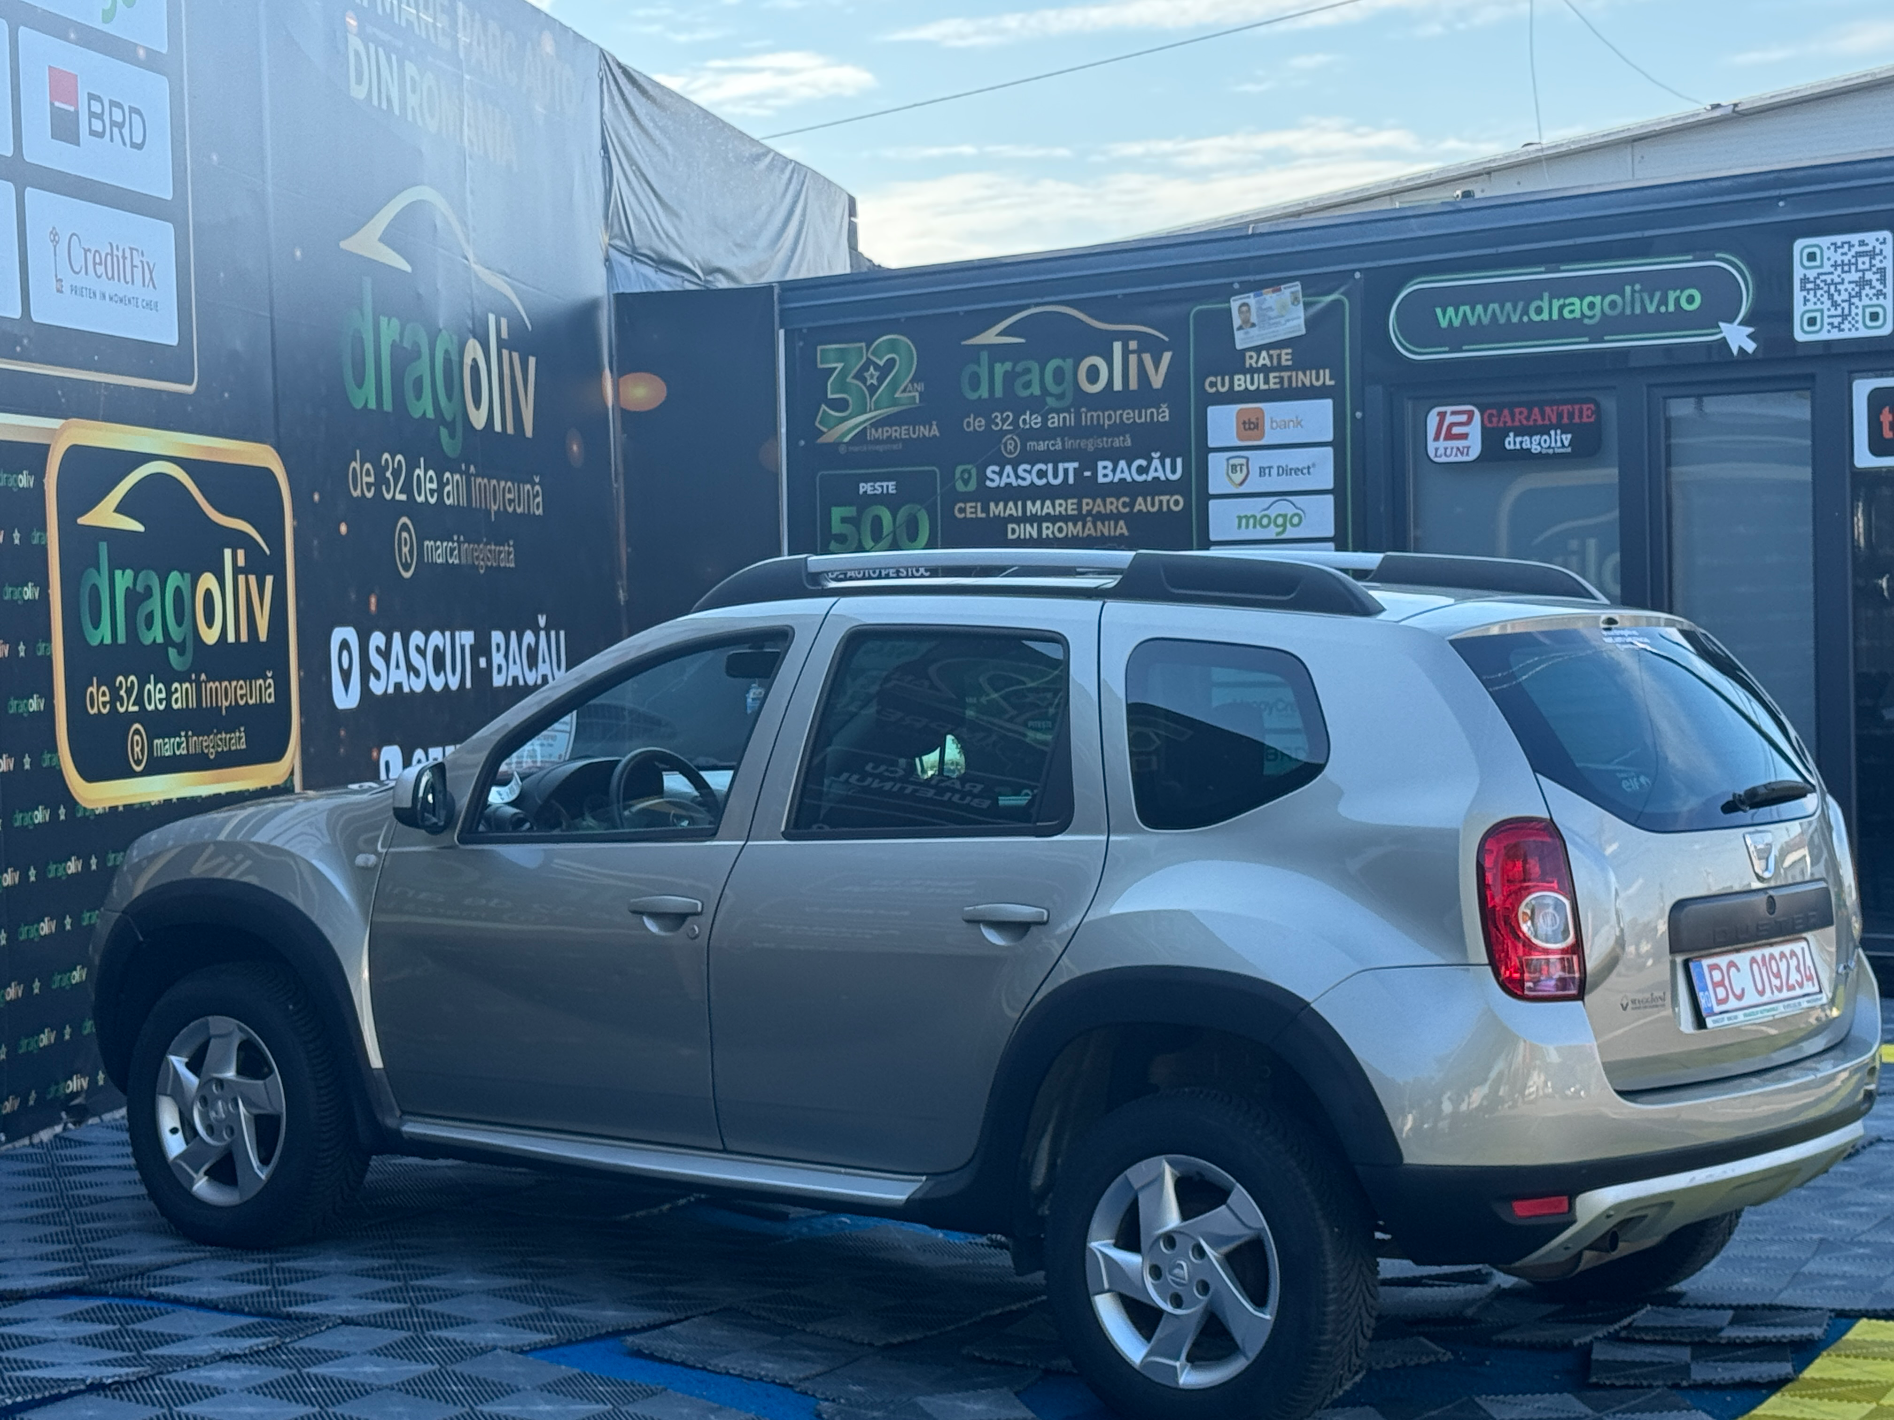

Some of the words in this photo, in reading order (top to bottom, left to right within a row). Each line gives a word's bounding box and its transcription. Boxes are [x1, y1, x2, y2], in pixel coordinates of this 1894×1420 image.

[347, 32, 400, 117] DIN
[87, 91, 147, 151] BRD
[67, 232, 157, 290] CreditFix
[70, 284, 97, 299] PRIETEN
[108, 293, 139, 308] MOMENTE
[1434, 283, 1702, 329] www.dragoliv.ro
[340, 275, 537, 459] dragoliv
[1245, 348, 1293, 368] RATE
[960, 340, 1173, 409] dragoliv
[1204, 375, 1230, 393] CU
[1233, 369, 1335, 392] BULETINUL
[906, 382, 925, 394] ANI
[964, 412, 985, 432] de
[991, 411, 1013, 431] 32
[1019, 410, 1042, 429] de
[1047, 408, 1075, 428] ani
[1081, 402, 1170, 429] împreună
[1241, 416, 1260, 432] tbi
[1269, 415, 1304, 431] bank
[1432, 409, 1475, 442] 12
[1483, 403, 1597, 428] GARANTIE
[866, 421, 940, 441] ÎMPREUNĂ
[1504, 428, 1573, 454] dragoliv
[1026, 438, 1062, 452] marcă
[1433, 445, 1472, 460] LUNI
[985, 462, 1079, 488] SASCUT
[1097, 451, 1183, 484] BACĂU
[1230, 463, 1245, 475] BT
[1258, 465, 1274, 478] BT
[348, 448, 375, 499] de
[381, 452, 408, 502] 32
[412, 457, 438, 505] de
[443, 463, 467, 507] ani
[470, 464, 544, 522] împreună
[859, 481, 897, 495] PESTE
[954, 501, 986, 519] CEL
[989, 500, 1022, 518] MAI
[1026, 498, 1078, 516] MARE
[1082, 497, 1130, 514] PARC
[1133, 494, 1184, 513] AUTO
[828, 503, 930, 553] 500
[1007, 522, 1038, 540] DIN
[1042, 517, 1129, 539] ROMÂNIA
[1236, 511, 1303, 538] mogo
[423, 534, 459, 565] marcă
[3, 581, 40, 605] dragoliv
[79, 540, 275, 672] dragoliv
[368, 629, 475, 696] SASCUT
[490, 614, 567, 688] BACĂU
[8, 693, 46, 717] dragoliv
[86, 676, 111, 715] de
[115, 674, 139, 714] 32
[144, 673, 166, 712] de
[171, 673, 197, 711] ani
[201, 669, 275, 716] împreună
[153, 730, 188, 758] marcă
[188, 726, 247, 760] înregistrată
[13, 804, 51, 829] dragoliv
[47, 855, 83, 880] dragoliv
[18, 916, 57, 942] dragoliv
[1706, 959, 1746, 1007] BC
[1748, 945, 1816, 998] 019234
